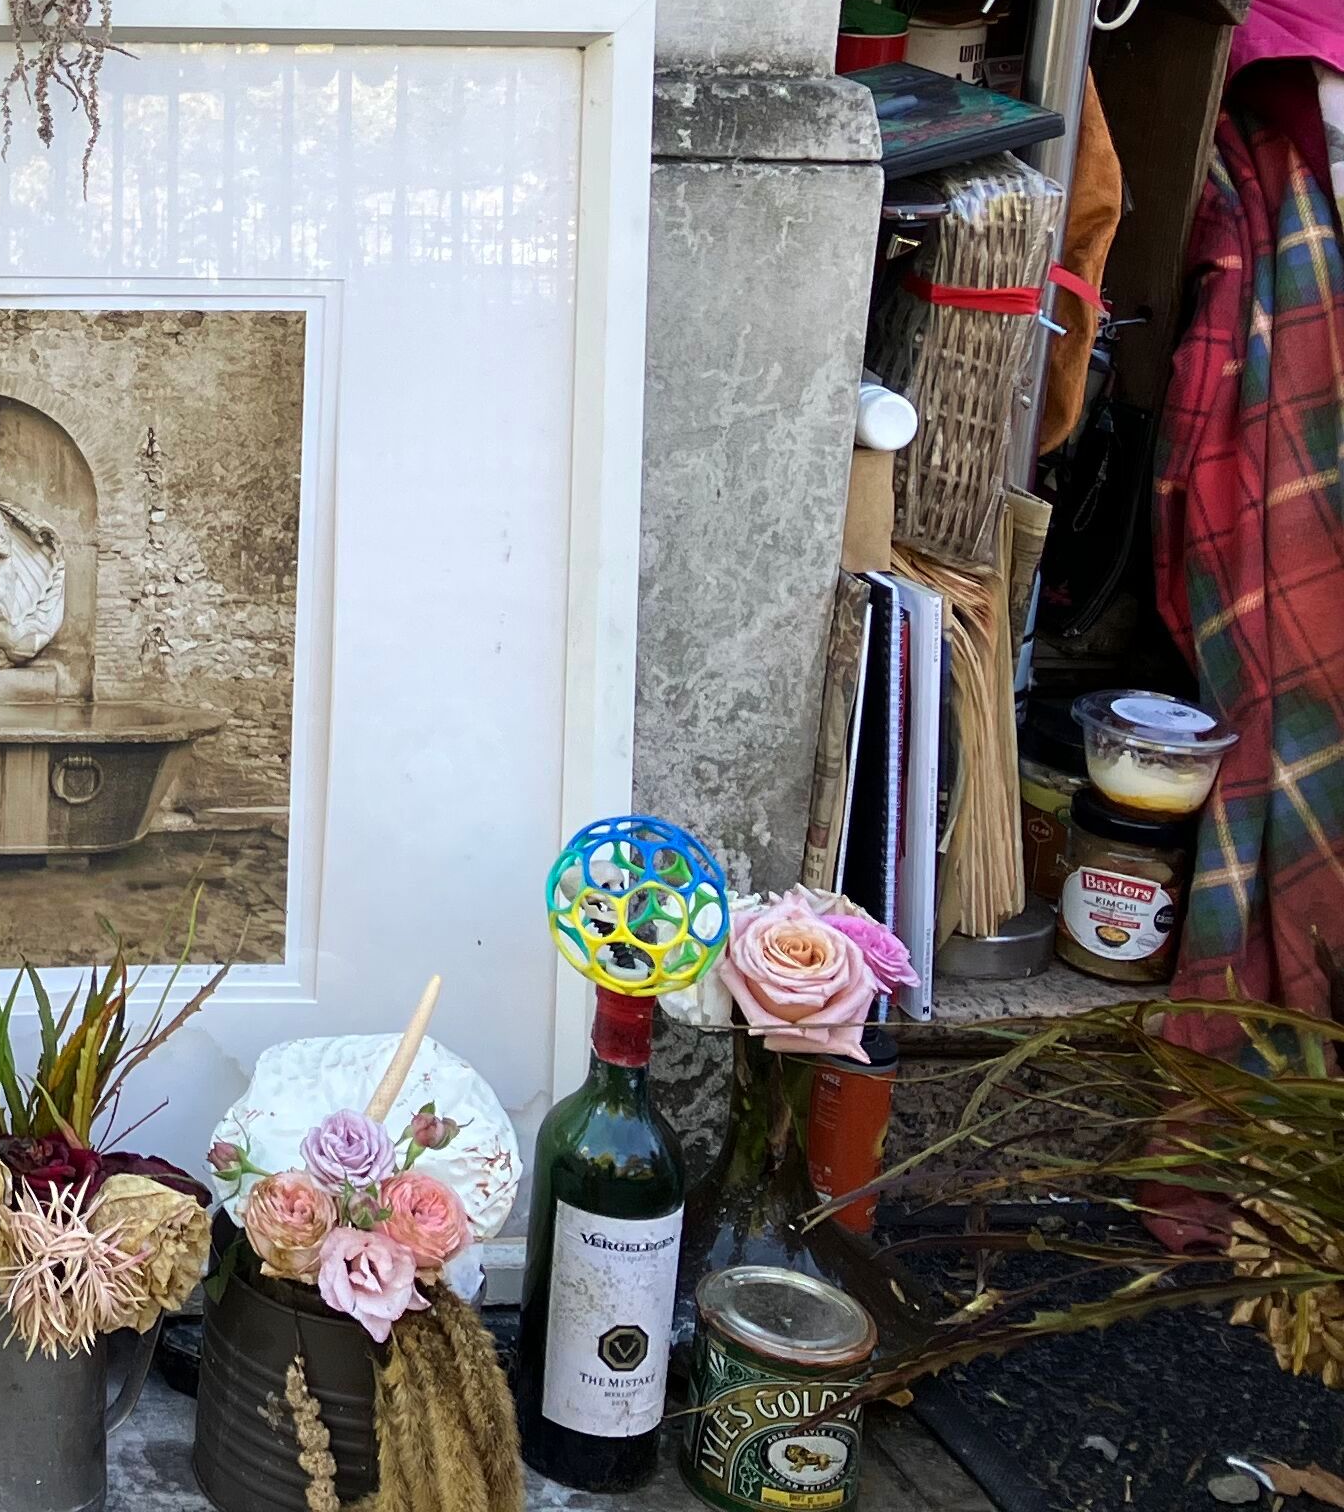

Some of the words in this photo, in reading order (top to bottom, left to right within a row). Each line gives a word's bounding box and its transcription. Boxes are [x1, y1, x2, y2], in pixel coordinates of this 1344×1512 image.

[1085, 873, 1152, 902] Baxters
[1095, 896, 1137, 913] KIMCHI
[579, 1372, 606, 1387] THE
[607, 1372, 656, 1388] MISTAKE
